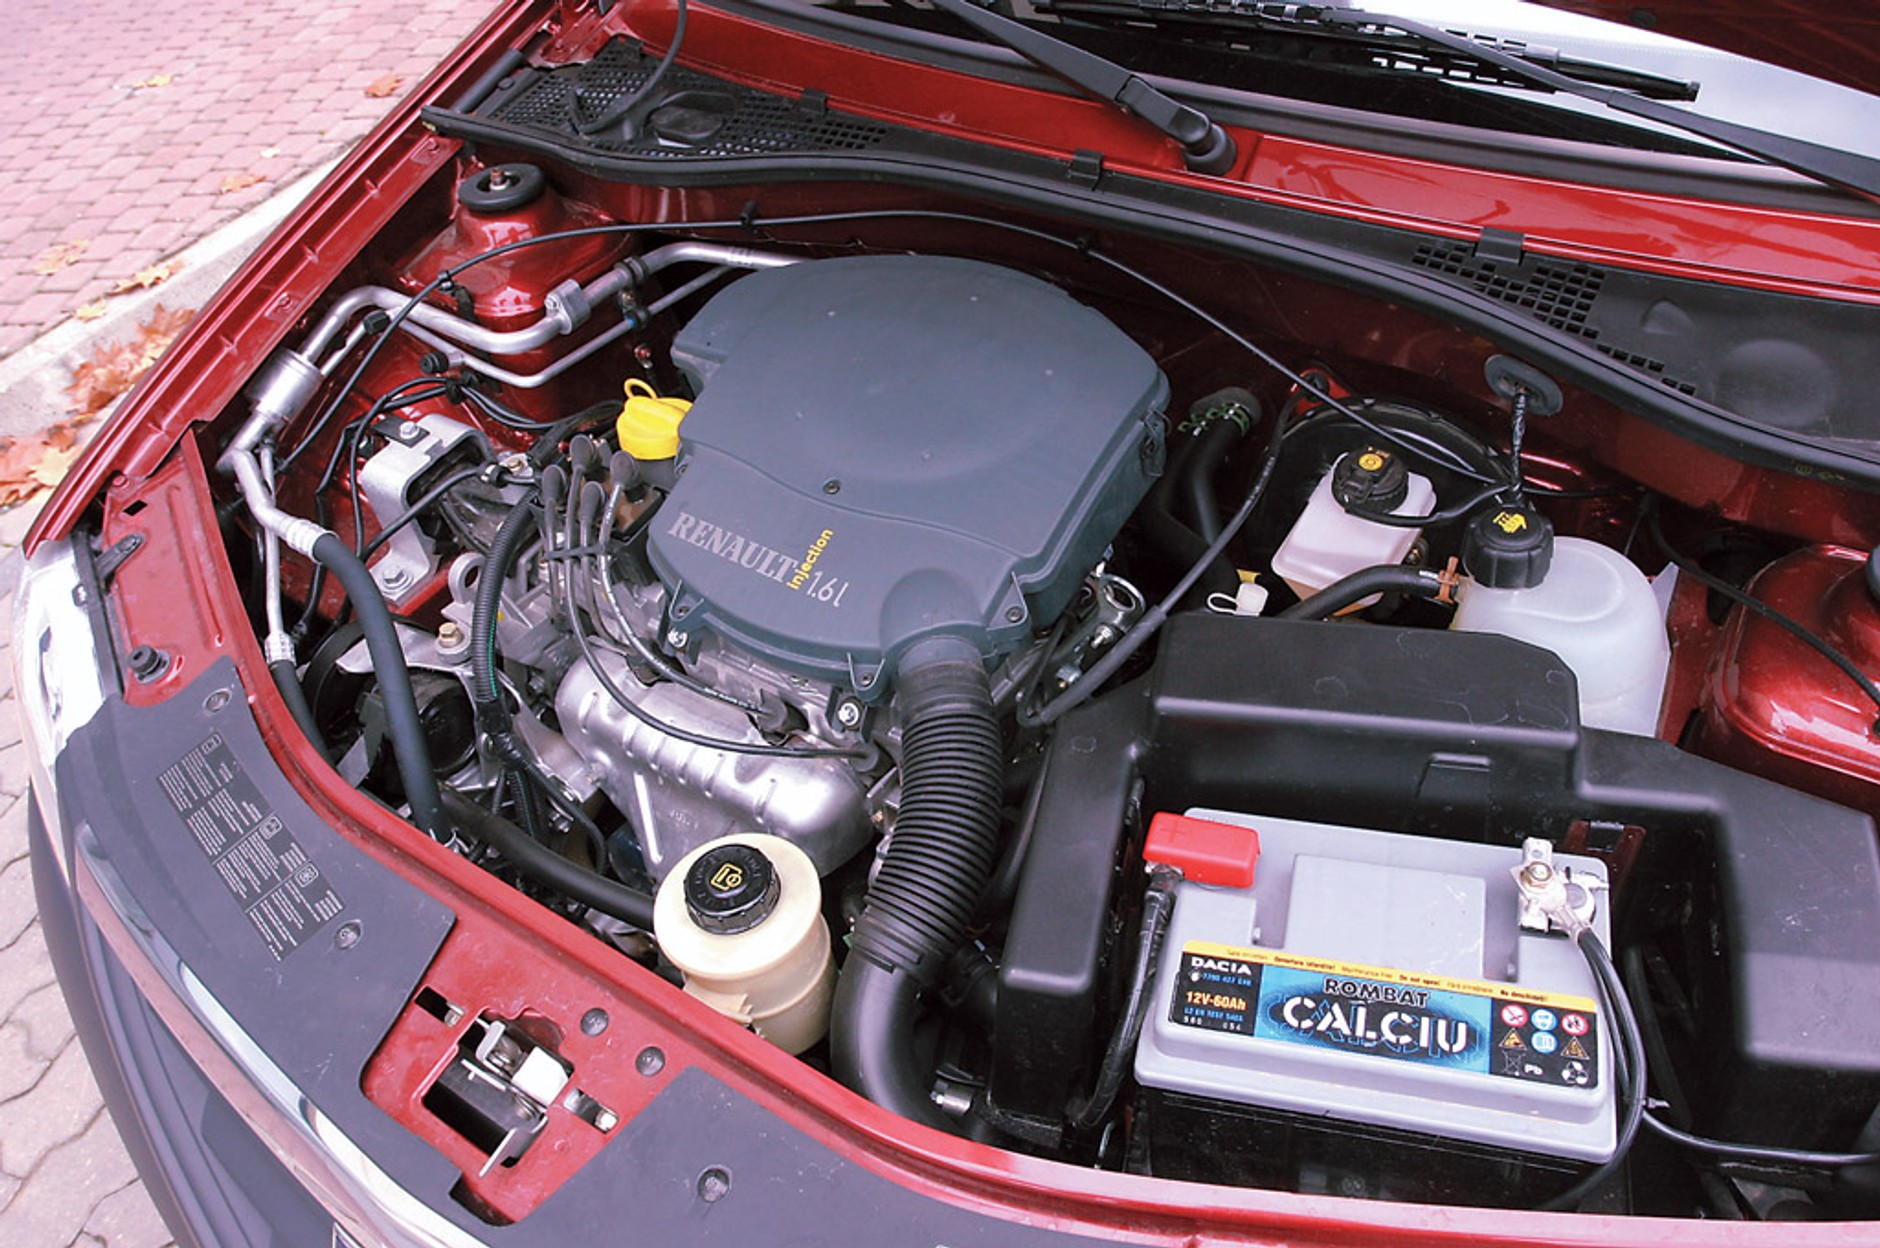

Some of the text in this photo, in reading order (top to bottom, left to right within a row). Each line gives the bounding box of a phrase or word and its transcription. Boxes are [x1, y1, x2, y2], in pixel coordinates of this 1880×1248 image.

[667, 512, 800, 584] RENAULT
[786, 528, 834, 591] injection
[1191, 956, 1252, 975] DACIA
[1186, 991, 1247, 1011] 12V-60Ah
[1323, 976, 1430, 1008] ROMBAT
[1283, 996, 1467, 1054] CALCIU
[1524, 1063, 1544, 1075] Pb
